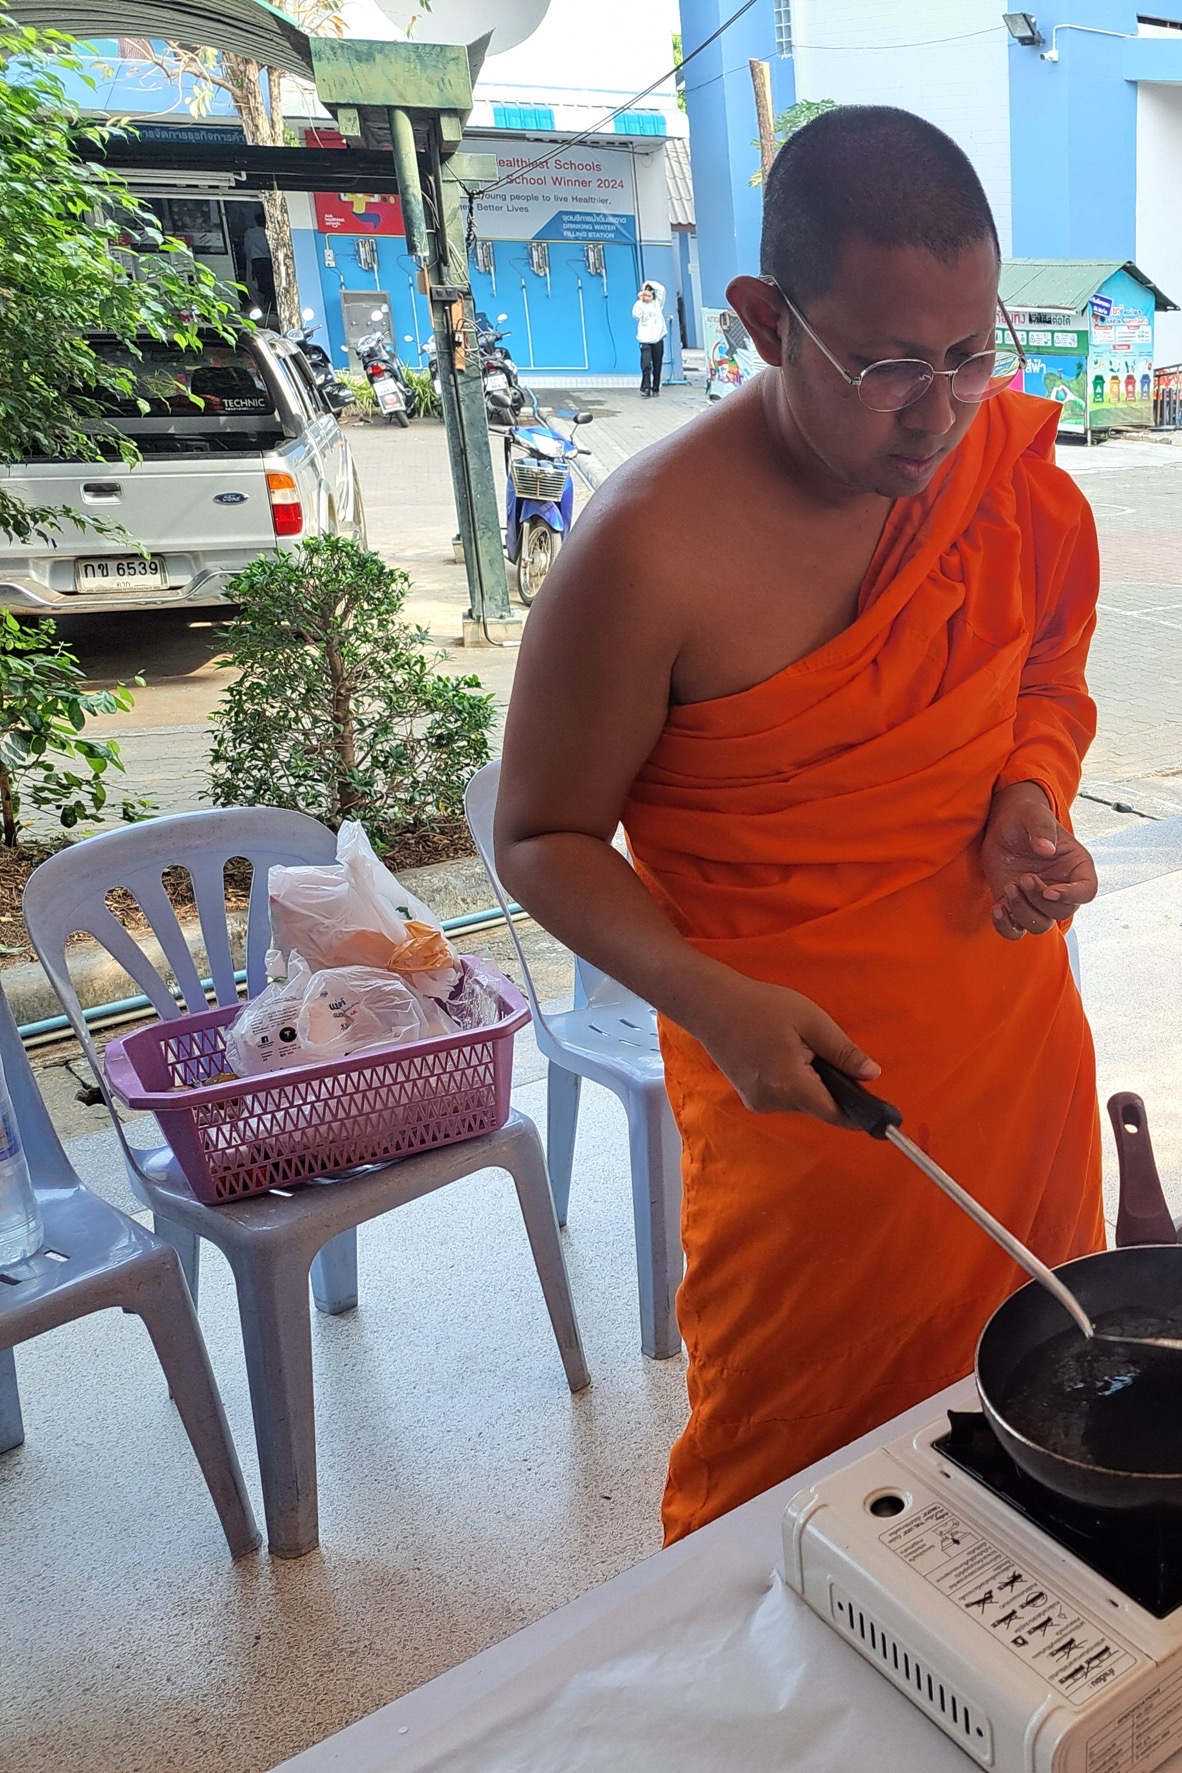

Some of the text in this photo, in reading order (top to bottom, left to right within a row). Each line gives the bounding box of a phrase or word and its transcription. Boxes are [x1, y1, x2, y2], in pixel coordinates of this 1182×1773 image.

[498, 157, 602, 172] ealthiest Schools
[505, 174, 547, 186] School
[551, 176, 592, 188] Winner
[597, 178, 625, 189] 2024
[510, 193, 540, 203] people
[542, 194, 550, 202] to
[553, 194, 568, 203] live
[477, 202, 504, 212] Better
[506, 203, 529, 213] Lives
[587, 231, 615, 239] STATION
[222, 398, 266, 408] TECHNIC
[83, 561, 159, 579] กข 6539
